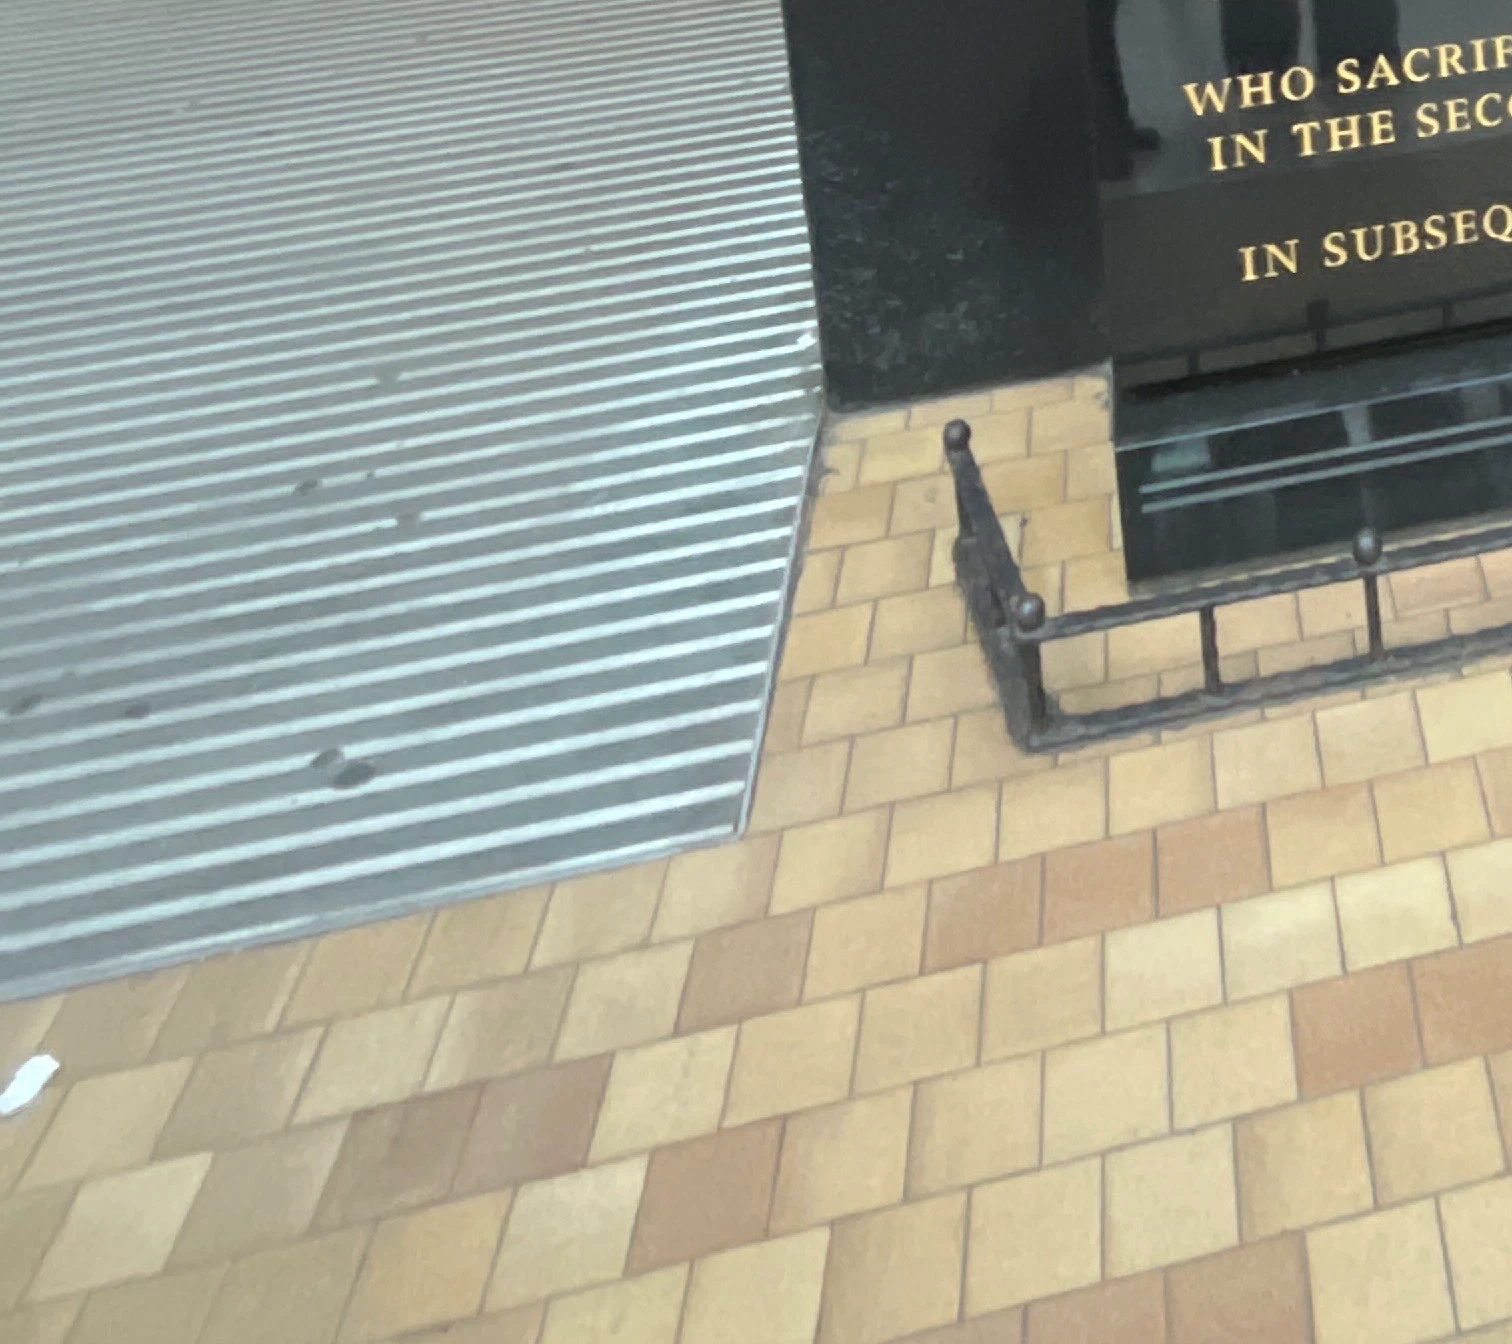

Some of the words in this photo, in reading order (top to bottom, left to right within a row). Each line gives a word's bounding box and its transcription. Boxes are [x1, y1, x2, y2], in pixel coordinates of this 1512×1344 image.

[1182, 66, 1316, 117] WHO
[1207, 130, 1268, 172] IN
[1291, 110, 1396, 157] THE
[1238, 239, 1300, 282] IN
